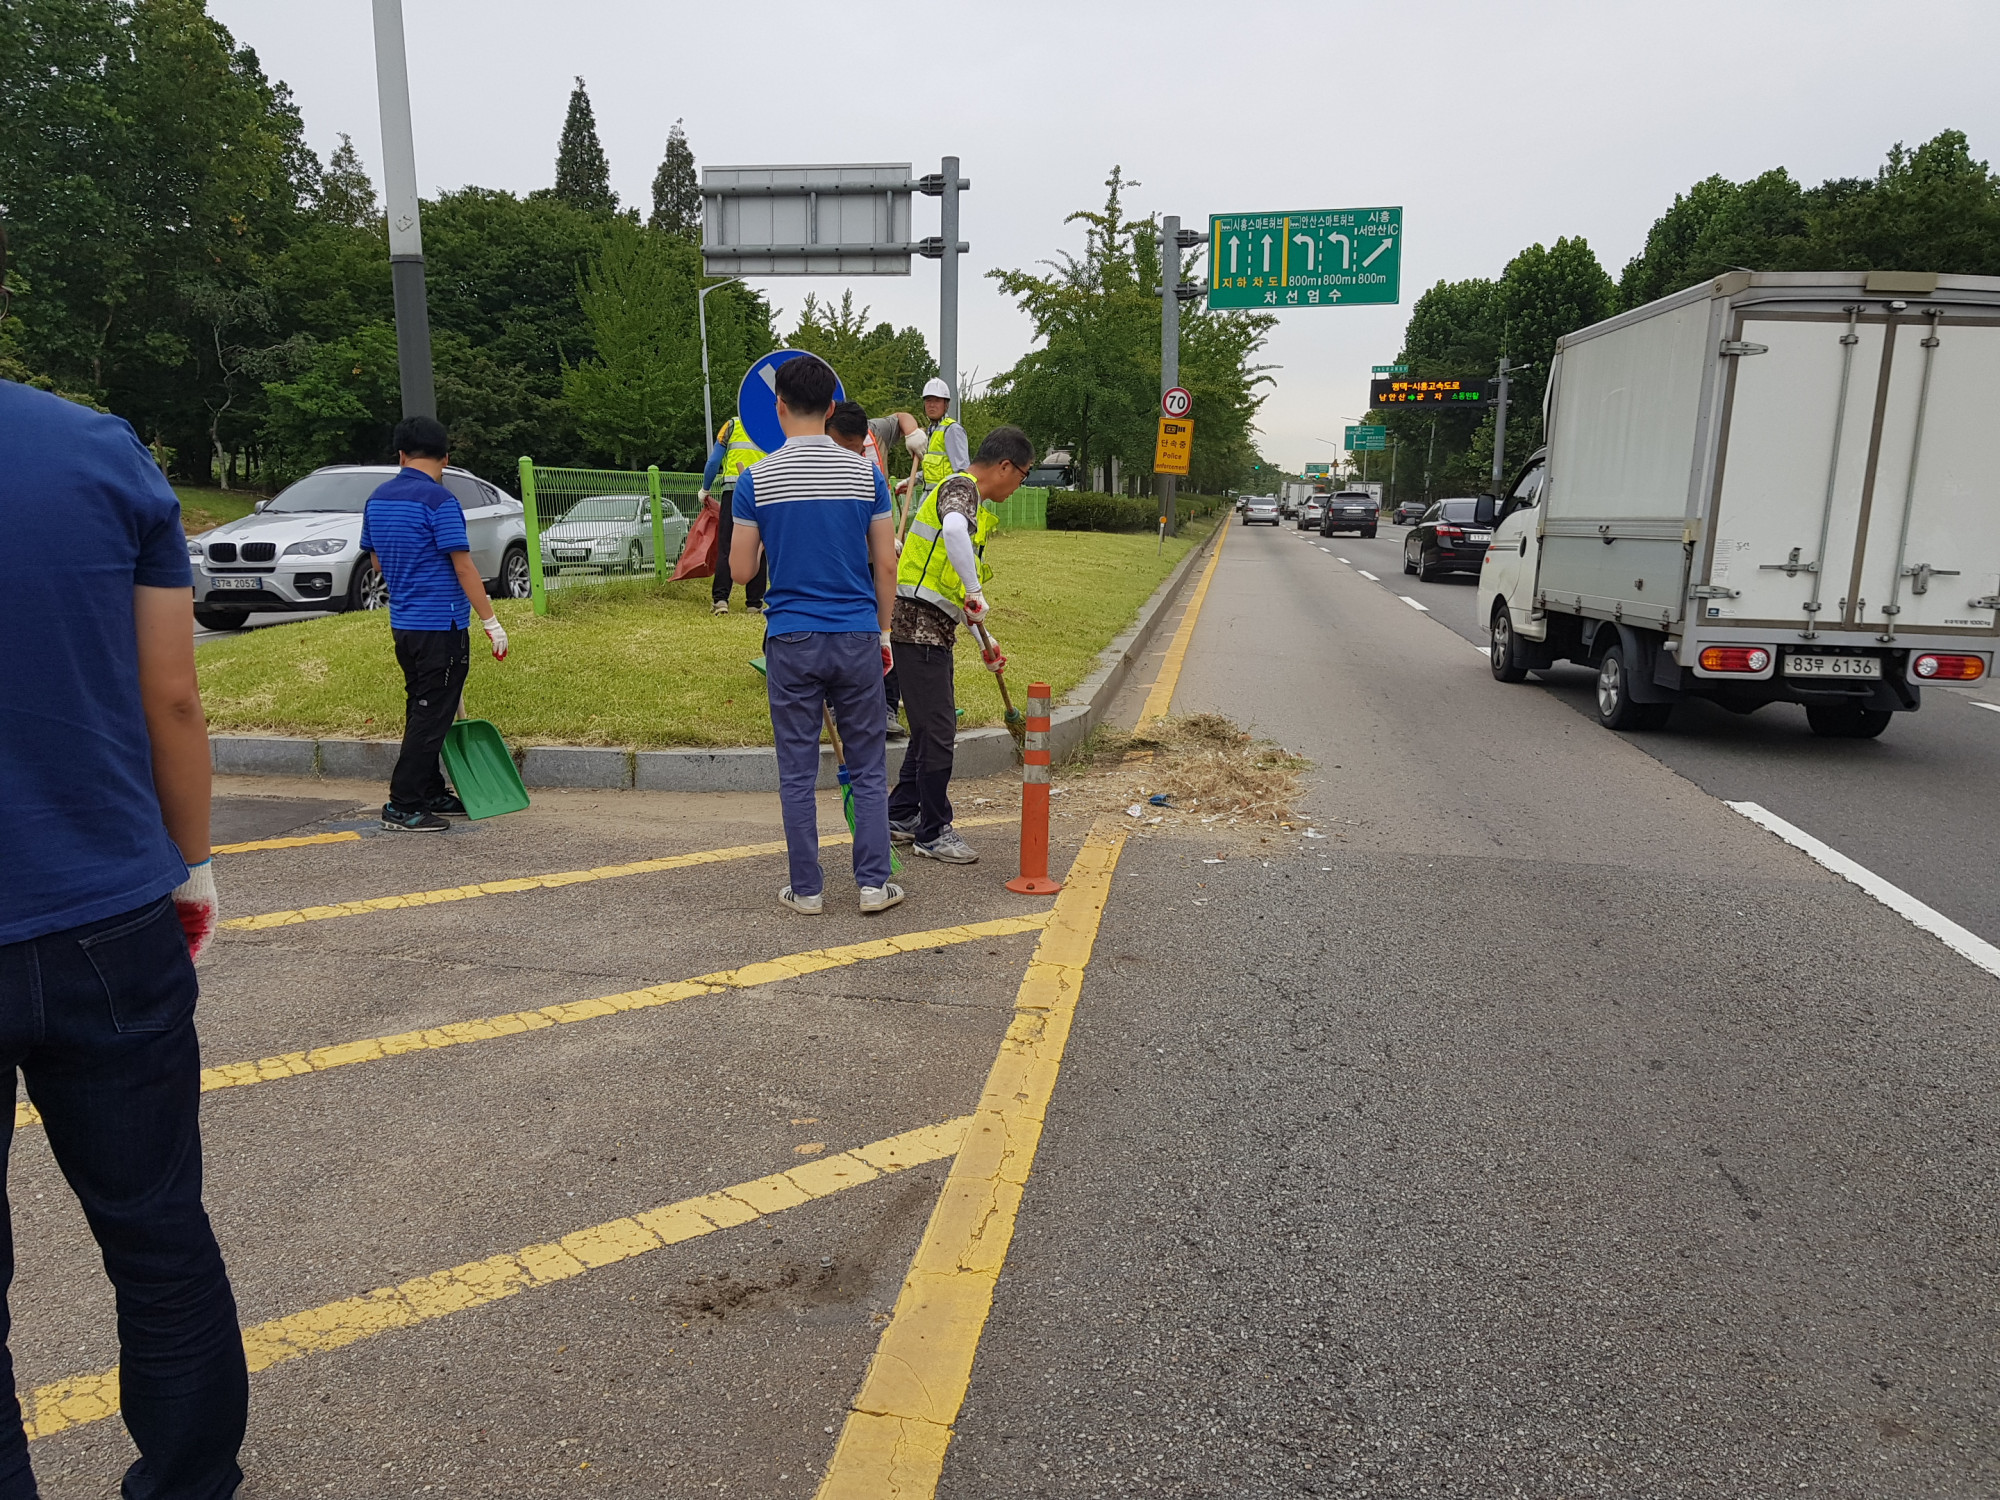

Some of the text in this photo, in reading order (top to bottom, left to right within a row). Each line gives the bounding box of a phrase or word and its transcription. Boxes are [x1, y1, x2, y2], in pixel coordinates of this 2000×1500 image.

[1301, 214, 1355, 229] 안산스마트허브
[1368, 211, 1390, 222] 시흥
[1233, 217, 1284, 231] 시흥스마트허브
[1358, 223, 1399, 236] 서안산IC
[1289, 275, 1317, 286] 800m
[1323, 274, 1351, 286] 800m
[1357, 273, 1386, 284] 800m
[1169, 395, 1186, 409] 70
[1161, 438, 1187, 449] 단속중
[1162, 451, 1182, 460] Police
[233, 579, 256, 588] 2052
[1793, 657, 1872, 674] 83무 6136
